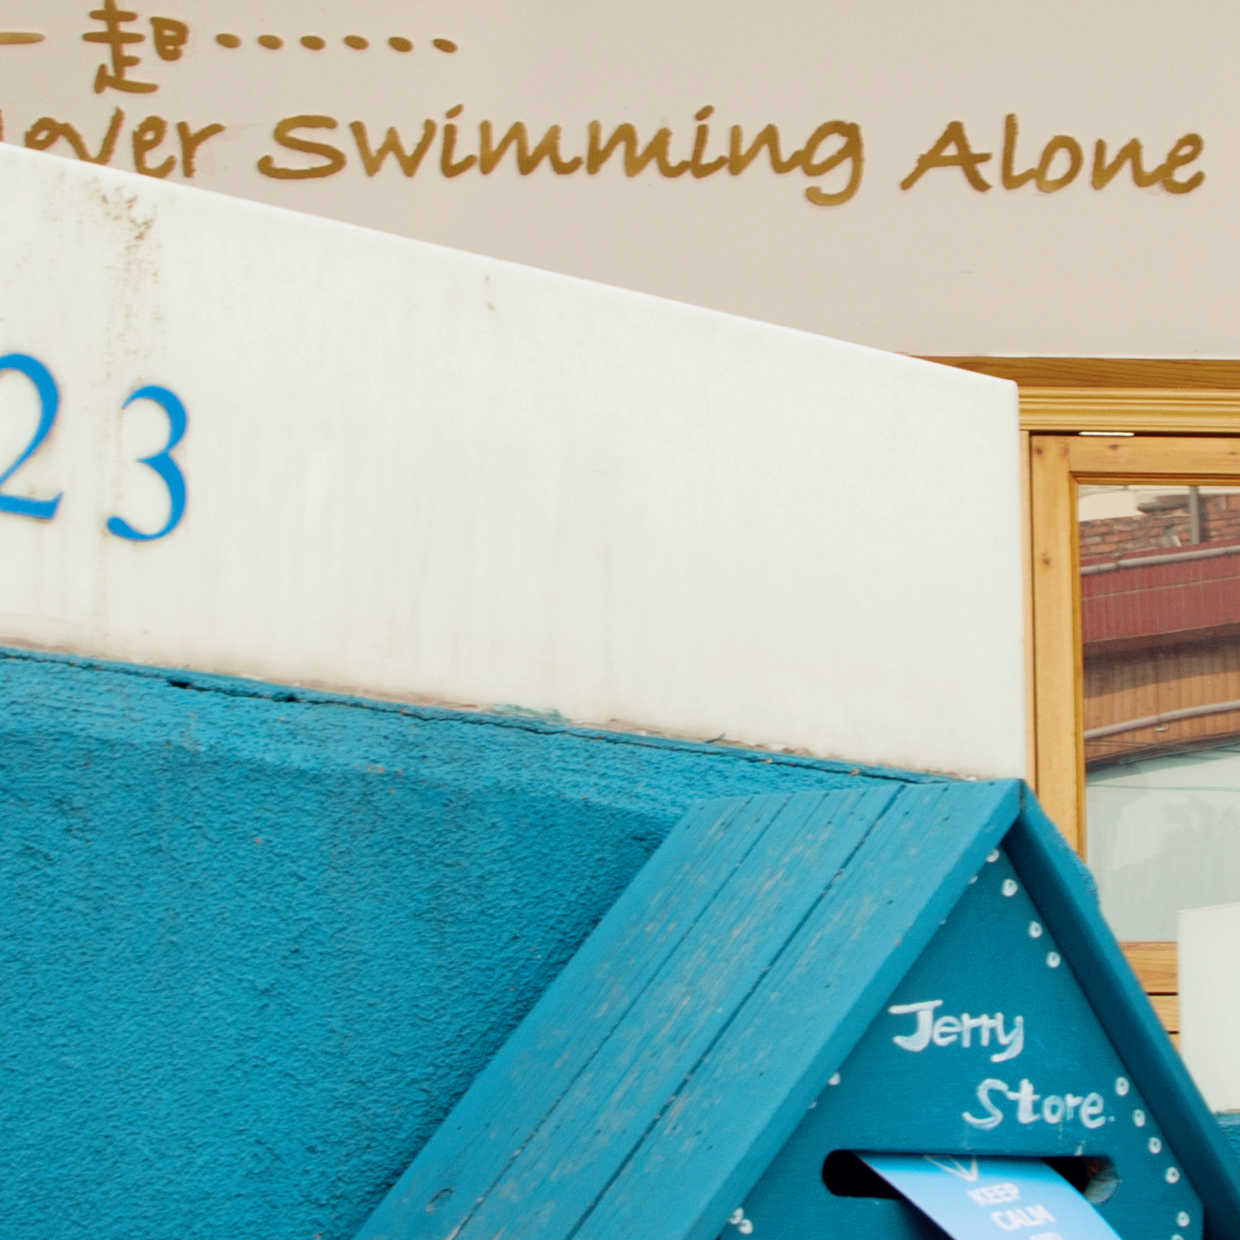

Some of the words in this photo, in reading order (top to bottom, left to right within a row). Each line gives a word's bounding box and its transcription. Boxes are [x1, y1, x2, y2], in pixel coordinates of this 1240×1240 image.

[900, 113, 1204, 194] Alone
[889, 1000, 1025, 1063] Jerry
[962, 1078, 1107, 1130] Store
[990, 1204, 1057, 1232] CALM
